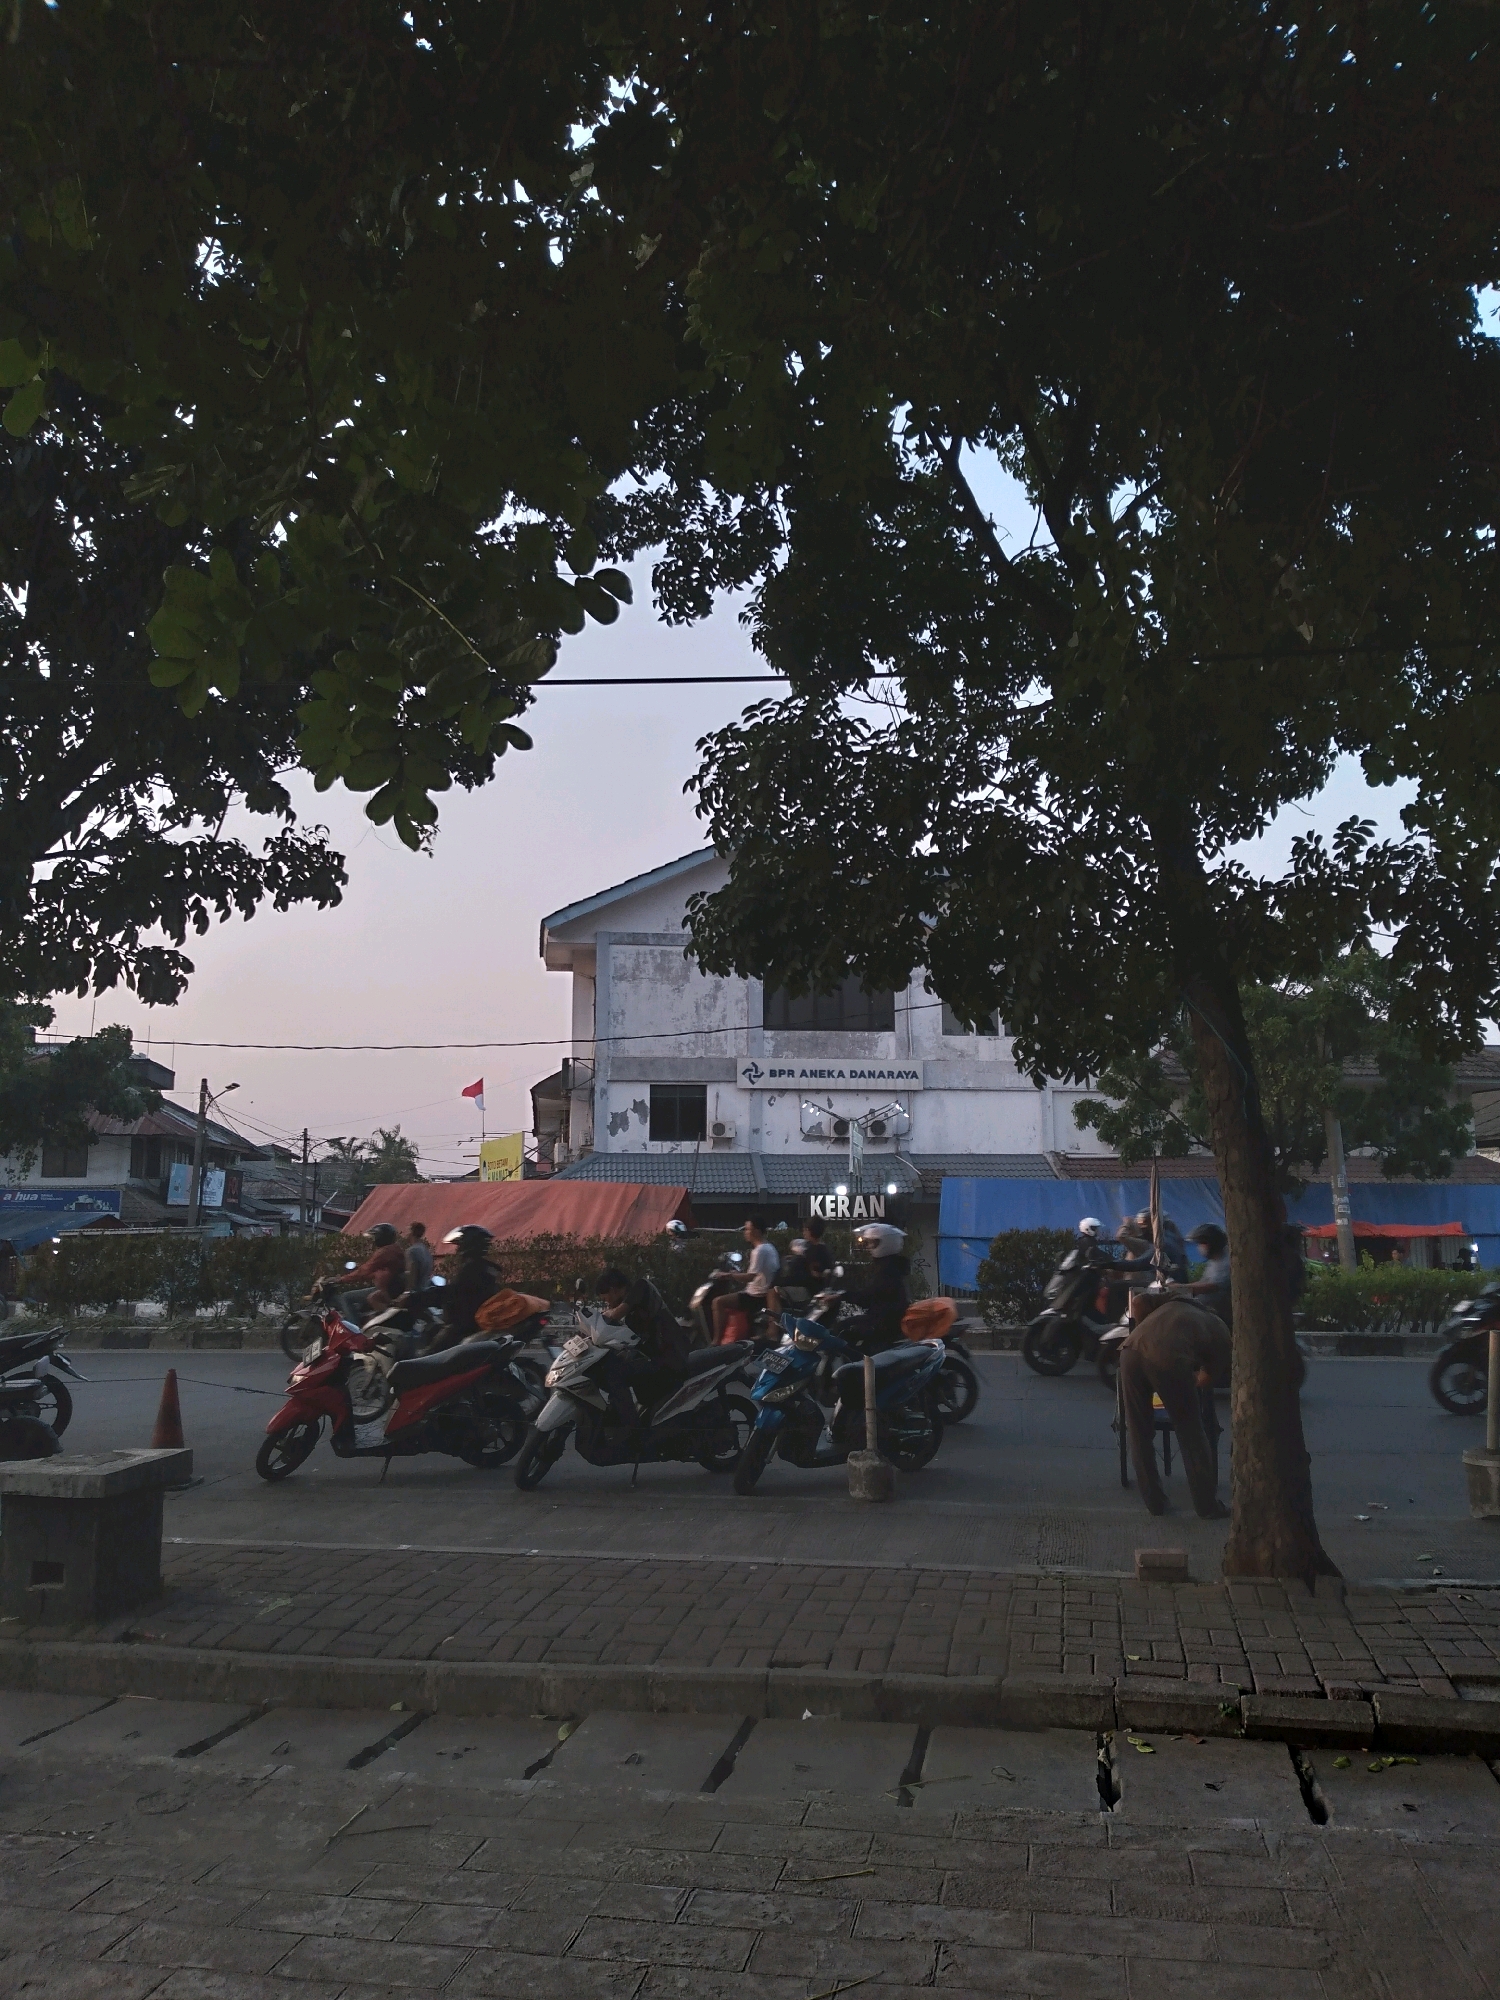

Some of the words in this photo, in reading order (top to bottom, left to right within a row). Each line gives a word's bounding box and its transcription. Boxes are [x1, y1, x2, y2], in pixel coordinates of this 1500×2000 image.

[769, 1068, 796, 1078] BPR
[799, 1069, 846, 1079] ANEKA
[849, 1069, 919, 1080] DANARAYA
[810, 1194, 885, 1218] KERAN
